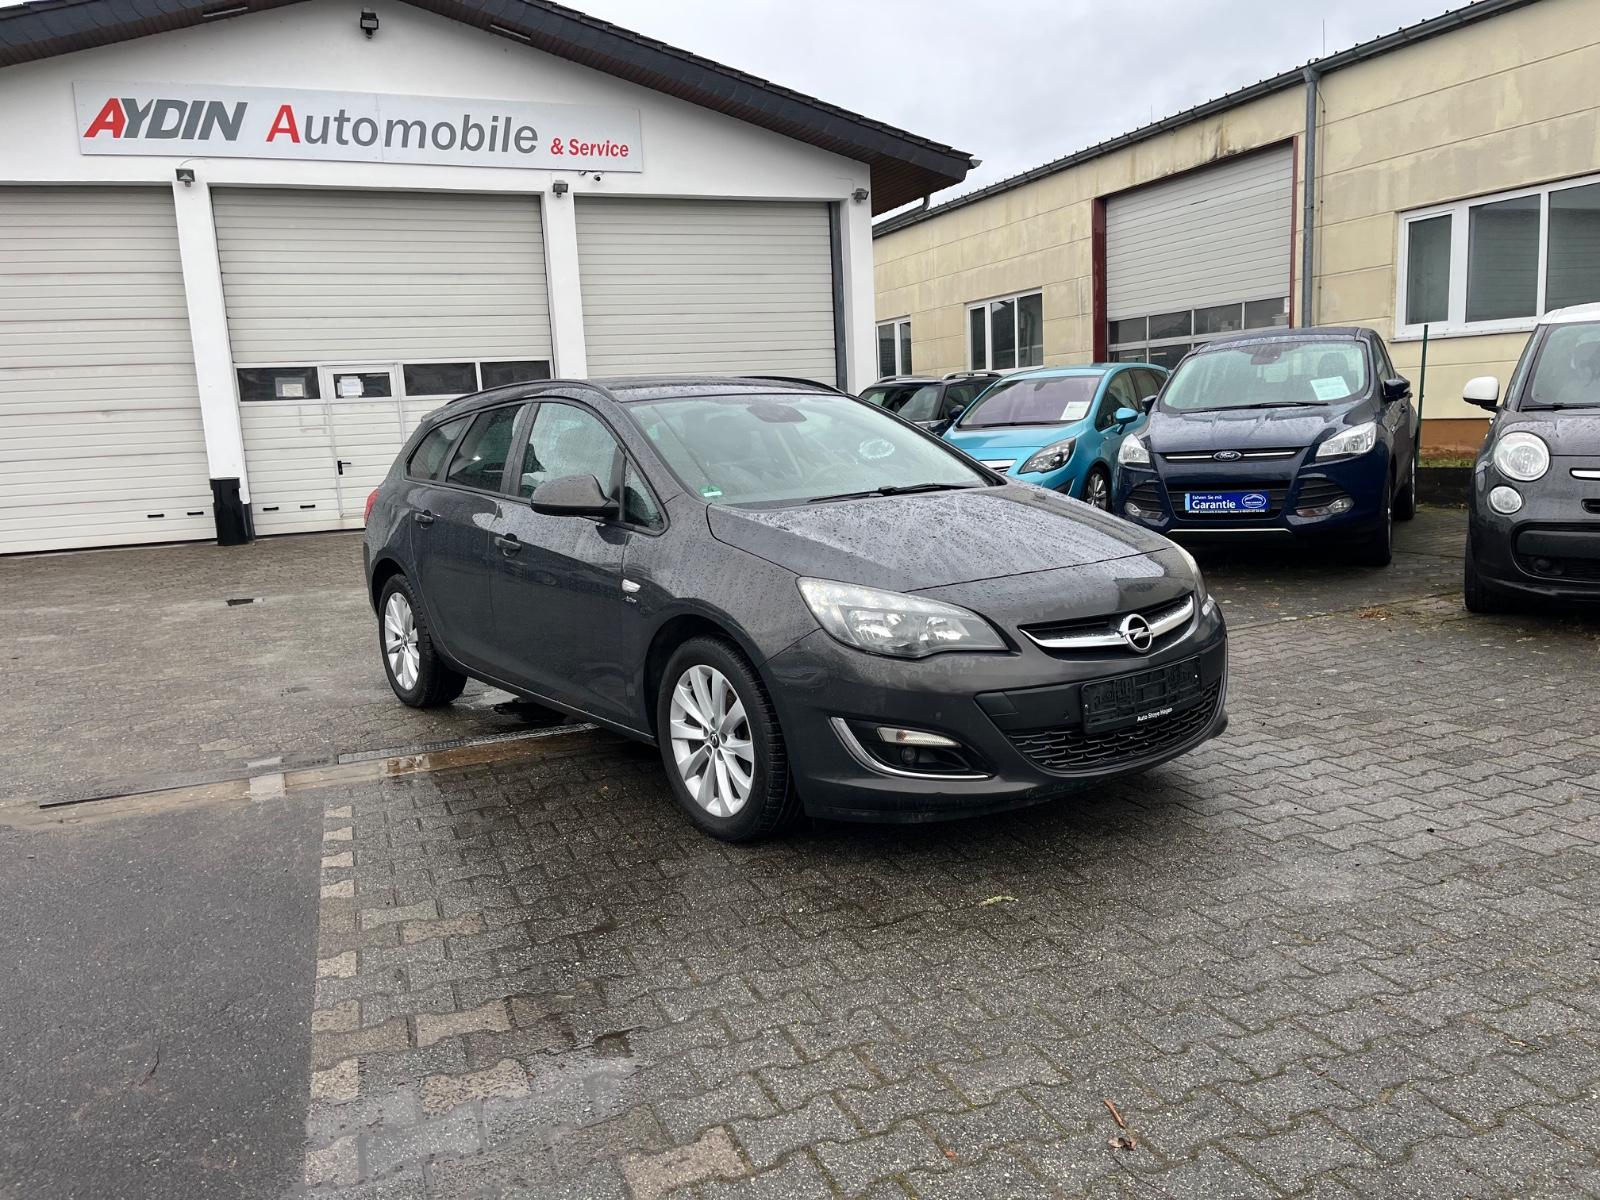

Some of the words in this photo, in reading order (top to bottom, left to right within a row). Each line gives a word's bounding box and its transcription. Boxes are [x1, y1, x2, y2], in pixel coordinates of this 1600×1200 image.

[83, 97, 248, 141] AYDIN
[265, 104, 538, 154] Automobile
[550, 137, 564, 155] &
[568, 138, 629, 158] Service
[1192, 499, 1236, 509] Garantie
